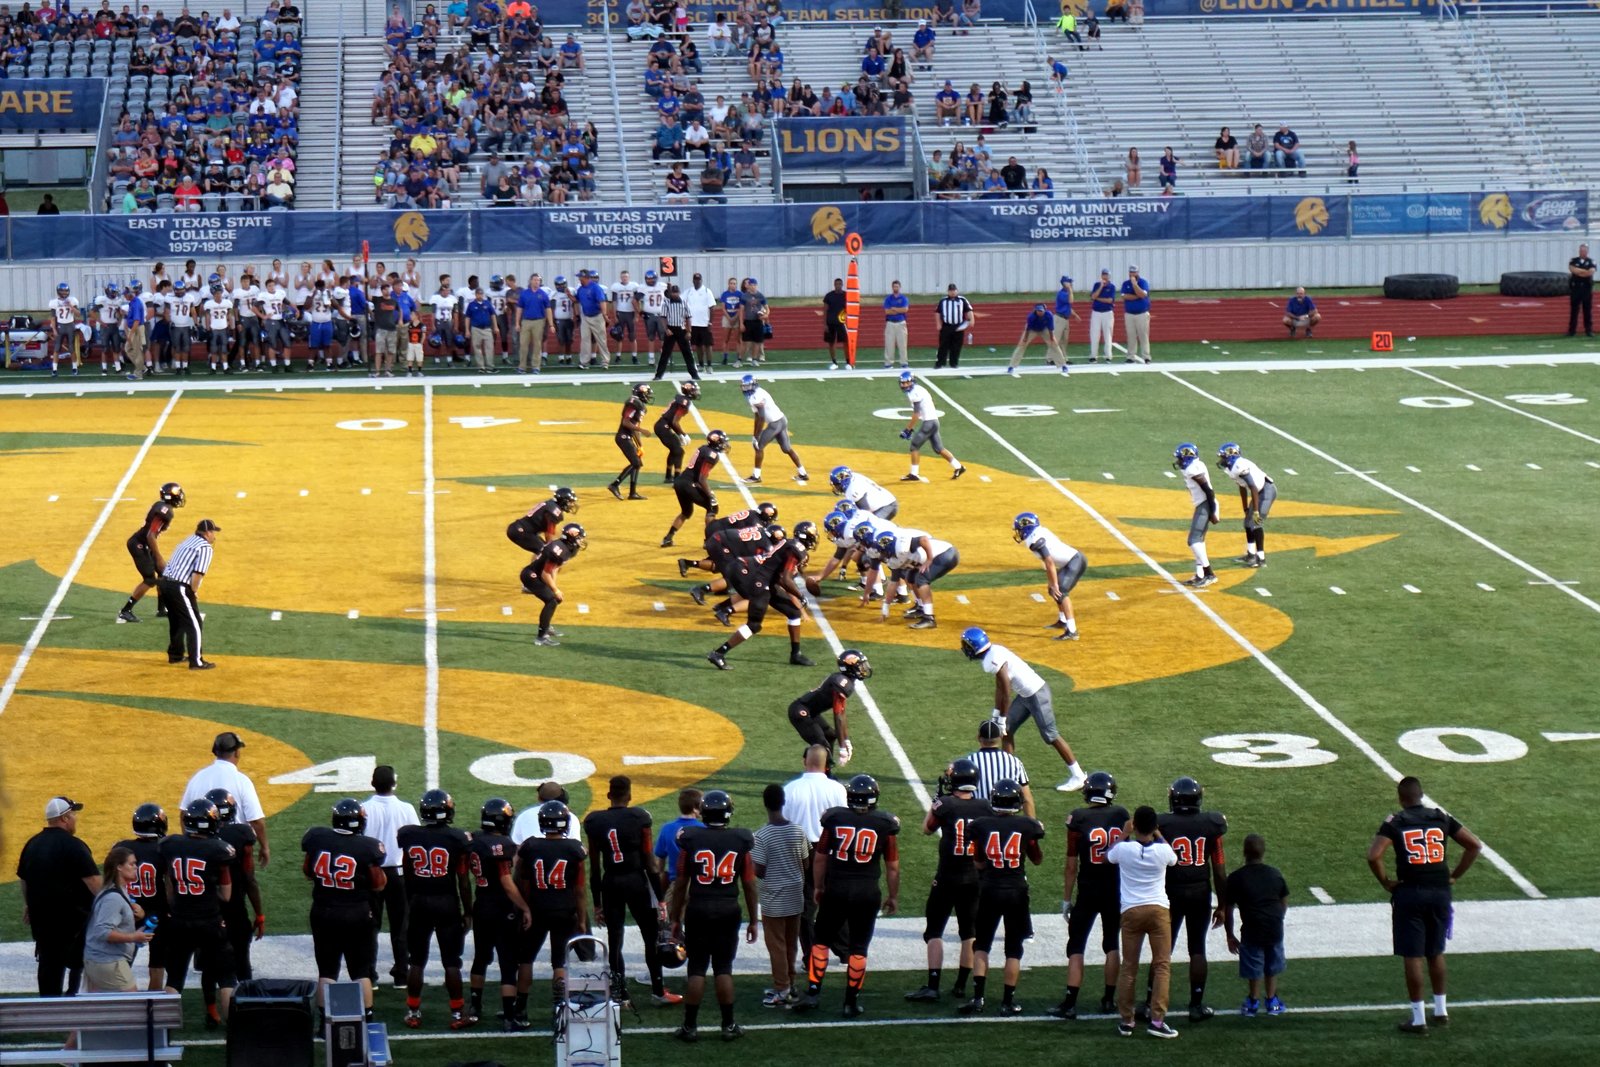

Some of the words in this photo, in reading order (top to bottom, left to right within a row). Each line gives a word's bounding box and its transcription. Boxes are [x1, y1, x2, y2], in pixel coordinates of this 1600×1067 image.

[779, 10, 828, 21] EAM
[0, 90, 73, 114] ARE
[781, 127, 900, 154] LIONS
[549, 212, 588, 223] EAST
[593, 211, 641, 222] TEXAS
[646, 210, 692, 222] STATE
[990, 205, 1038, 216] TEXAS
[1043, 204, 1076, 215] A&M
[1081, 201, 1170, 214] UNIVERSITY
[1425, 206, 1463, 216] Allstate
[128, 218, 167, 229] EAST
[172, 217, 221, 229] TEXAS
[226, 216, 272, 228] STATE
[576, 223, 665, 235] UNIVERSITY
[1037, 215, 1124, 227] COMMERCE
[169, 229, 237, 241] COLLEGE
[588, 235, 653, 247] 1962-1996
[1029, 227, 1131, 239] 1996-PRESENT
[168, 241, 233, 252] 1957-1962
[662, 257, 674, 273] 3
[649, 294, 662, 307] 60
[59, 307, 70, 319] 27
[1375, 333, 1392, 349] 20
[1202, 733, 1338, 768] 3
[1398, 727, 1528, 763] 0
[269, 755, 377, 793] 4
[469, 752, 597, 787] 0
[607, 828, 624, 864] 1
[835, 826, 878, 863] 70
[953, 818, 976, 857] 1
[1402, 828, 1445, 865] 56
[985, 831, 1022, 869] 44
[1171, 836, 1207, 867] 31
[313, 851, 358, 890] 42
[408, 846, 450, 878] 28
[694, 849, 738, 884] 34
[172, 857, 207, 895] 15
[534, 858, 568, 890] 14
